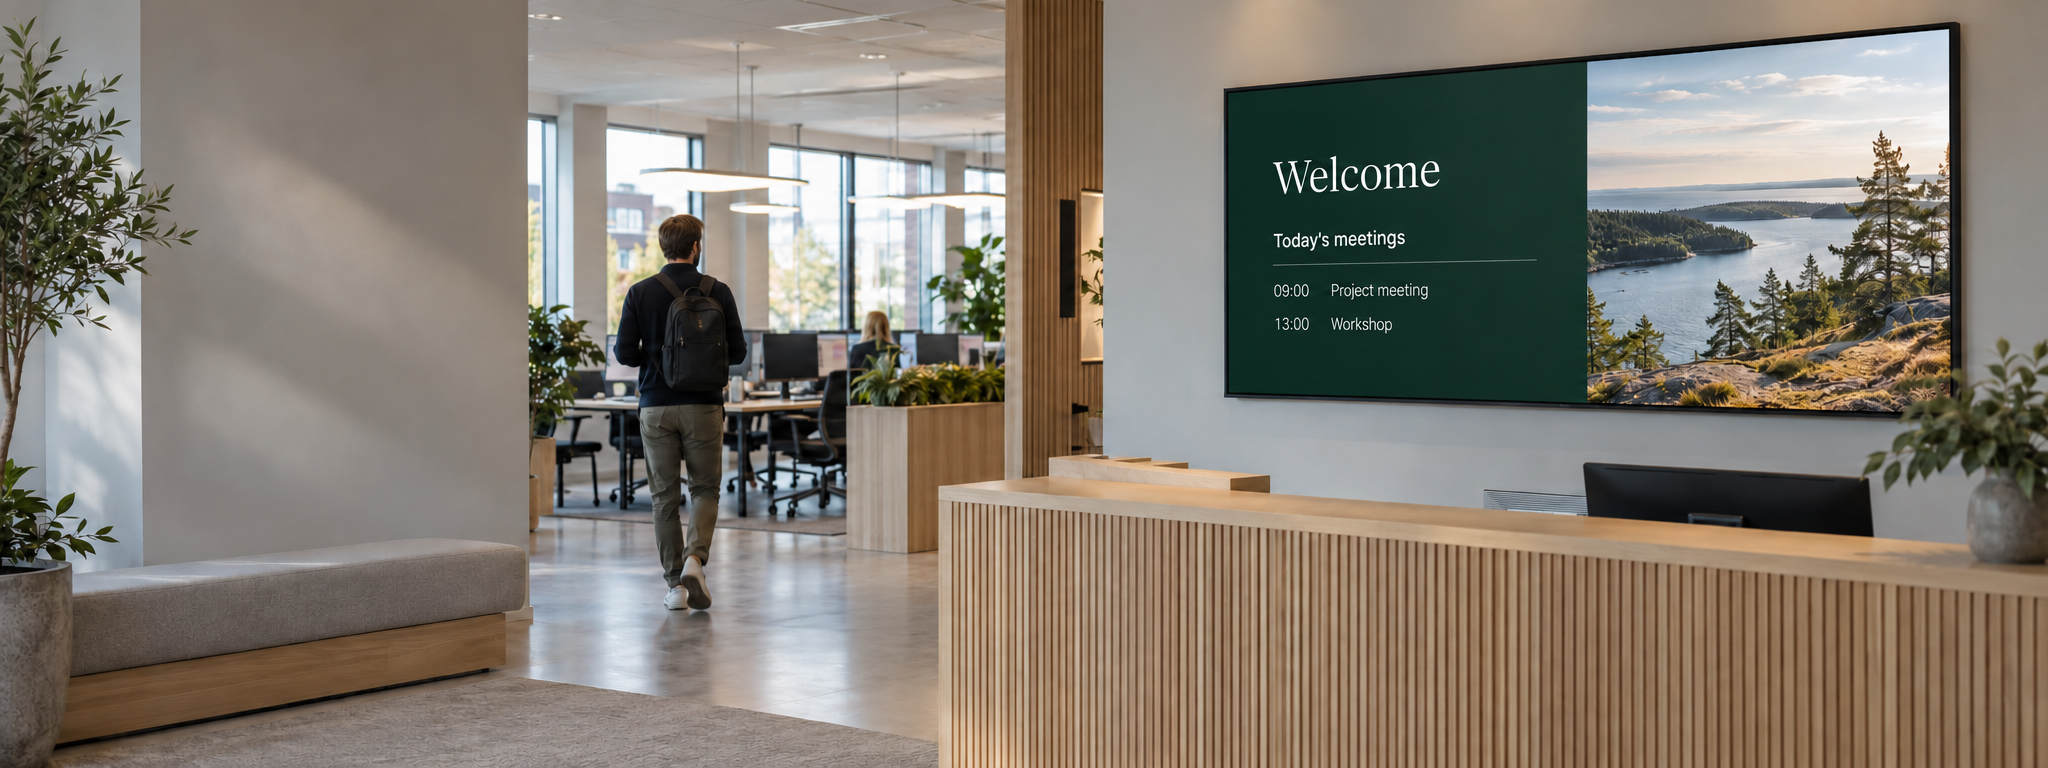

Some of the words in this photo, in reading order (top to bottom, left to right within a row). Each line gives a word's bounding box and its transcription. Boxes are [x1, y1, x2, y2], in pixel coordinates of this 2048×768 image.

[1272, 155, 1440, 194] Welcome
[1273, 232, 1330, 251] Today's
[1334, 230, 1406, 249] meetings
[1273, 283, 1310, 298] 09:00
[1331, 283, 1374, 300] Project
[1377, 283, 1429, 300] meeting
[1275, 316, 1310, 331] 13:00
[1331, 316, 1393, 334] Workshop
